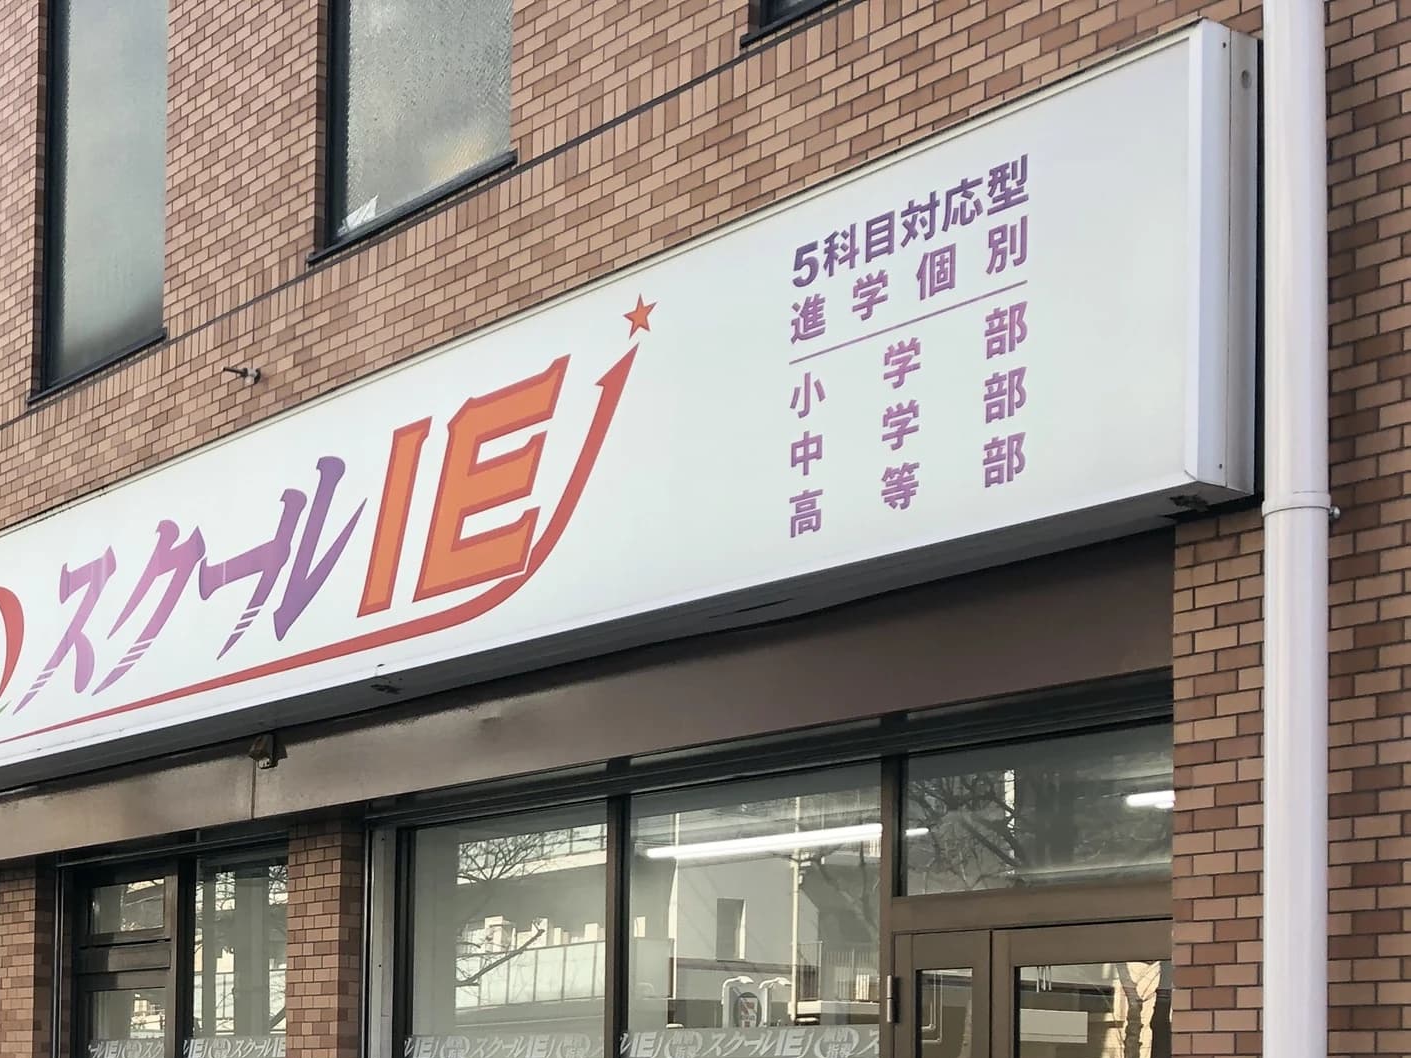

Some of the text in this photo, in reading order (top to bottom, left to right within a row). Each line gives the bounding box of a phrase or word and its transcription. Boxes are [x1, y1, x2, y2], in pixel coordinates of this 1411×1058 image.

[789, 216, 1029, 346] 進学個別
[791, 153, 1030, 288] 5科目対応型
[789, 302, 1027, 420] 小学部
[789, 367, 1027, 476] 中学部
[12, 355, 570, 715] スクールIE
[788, 432, 1026, 538] 高等部
